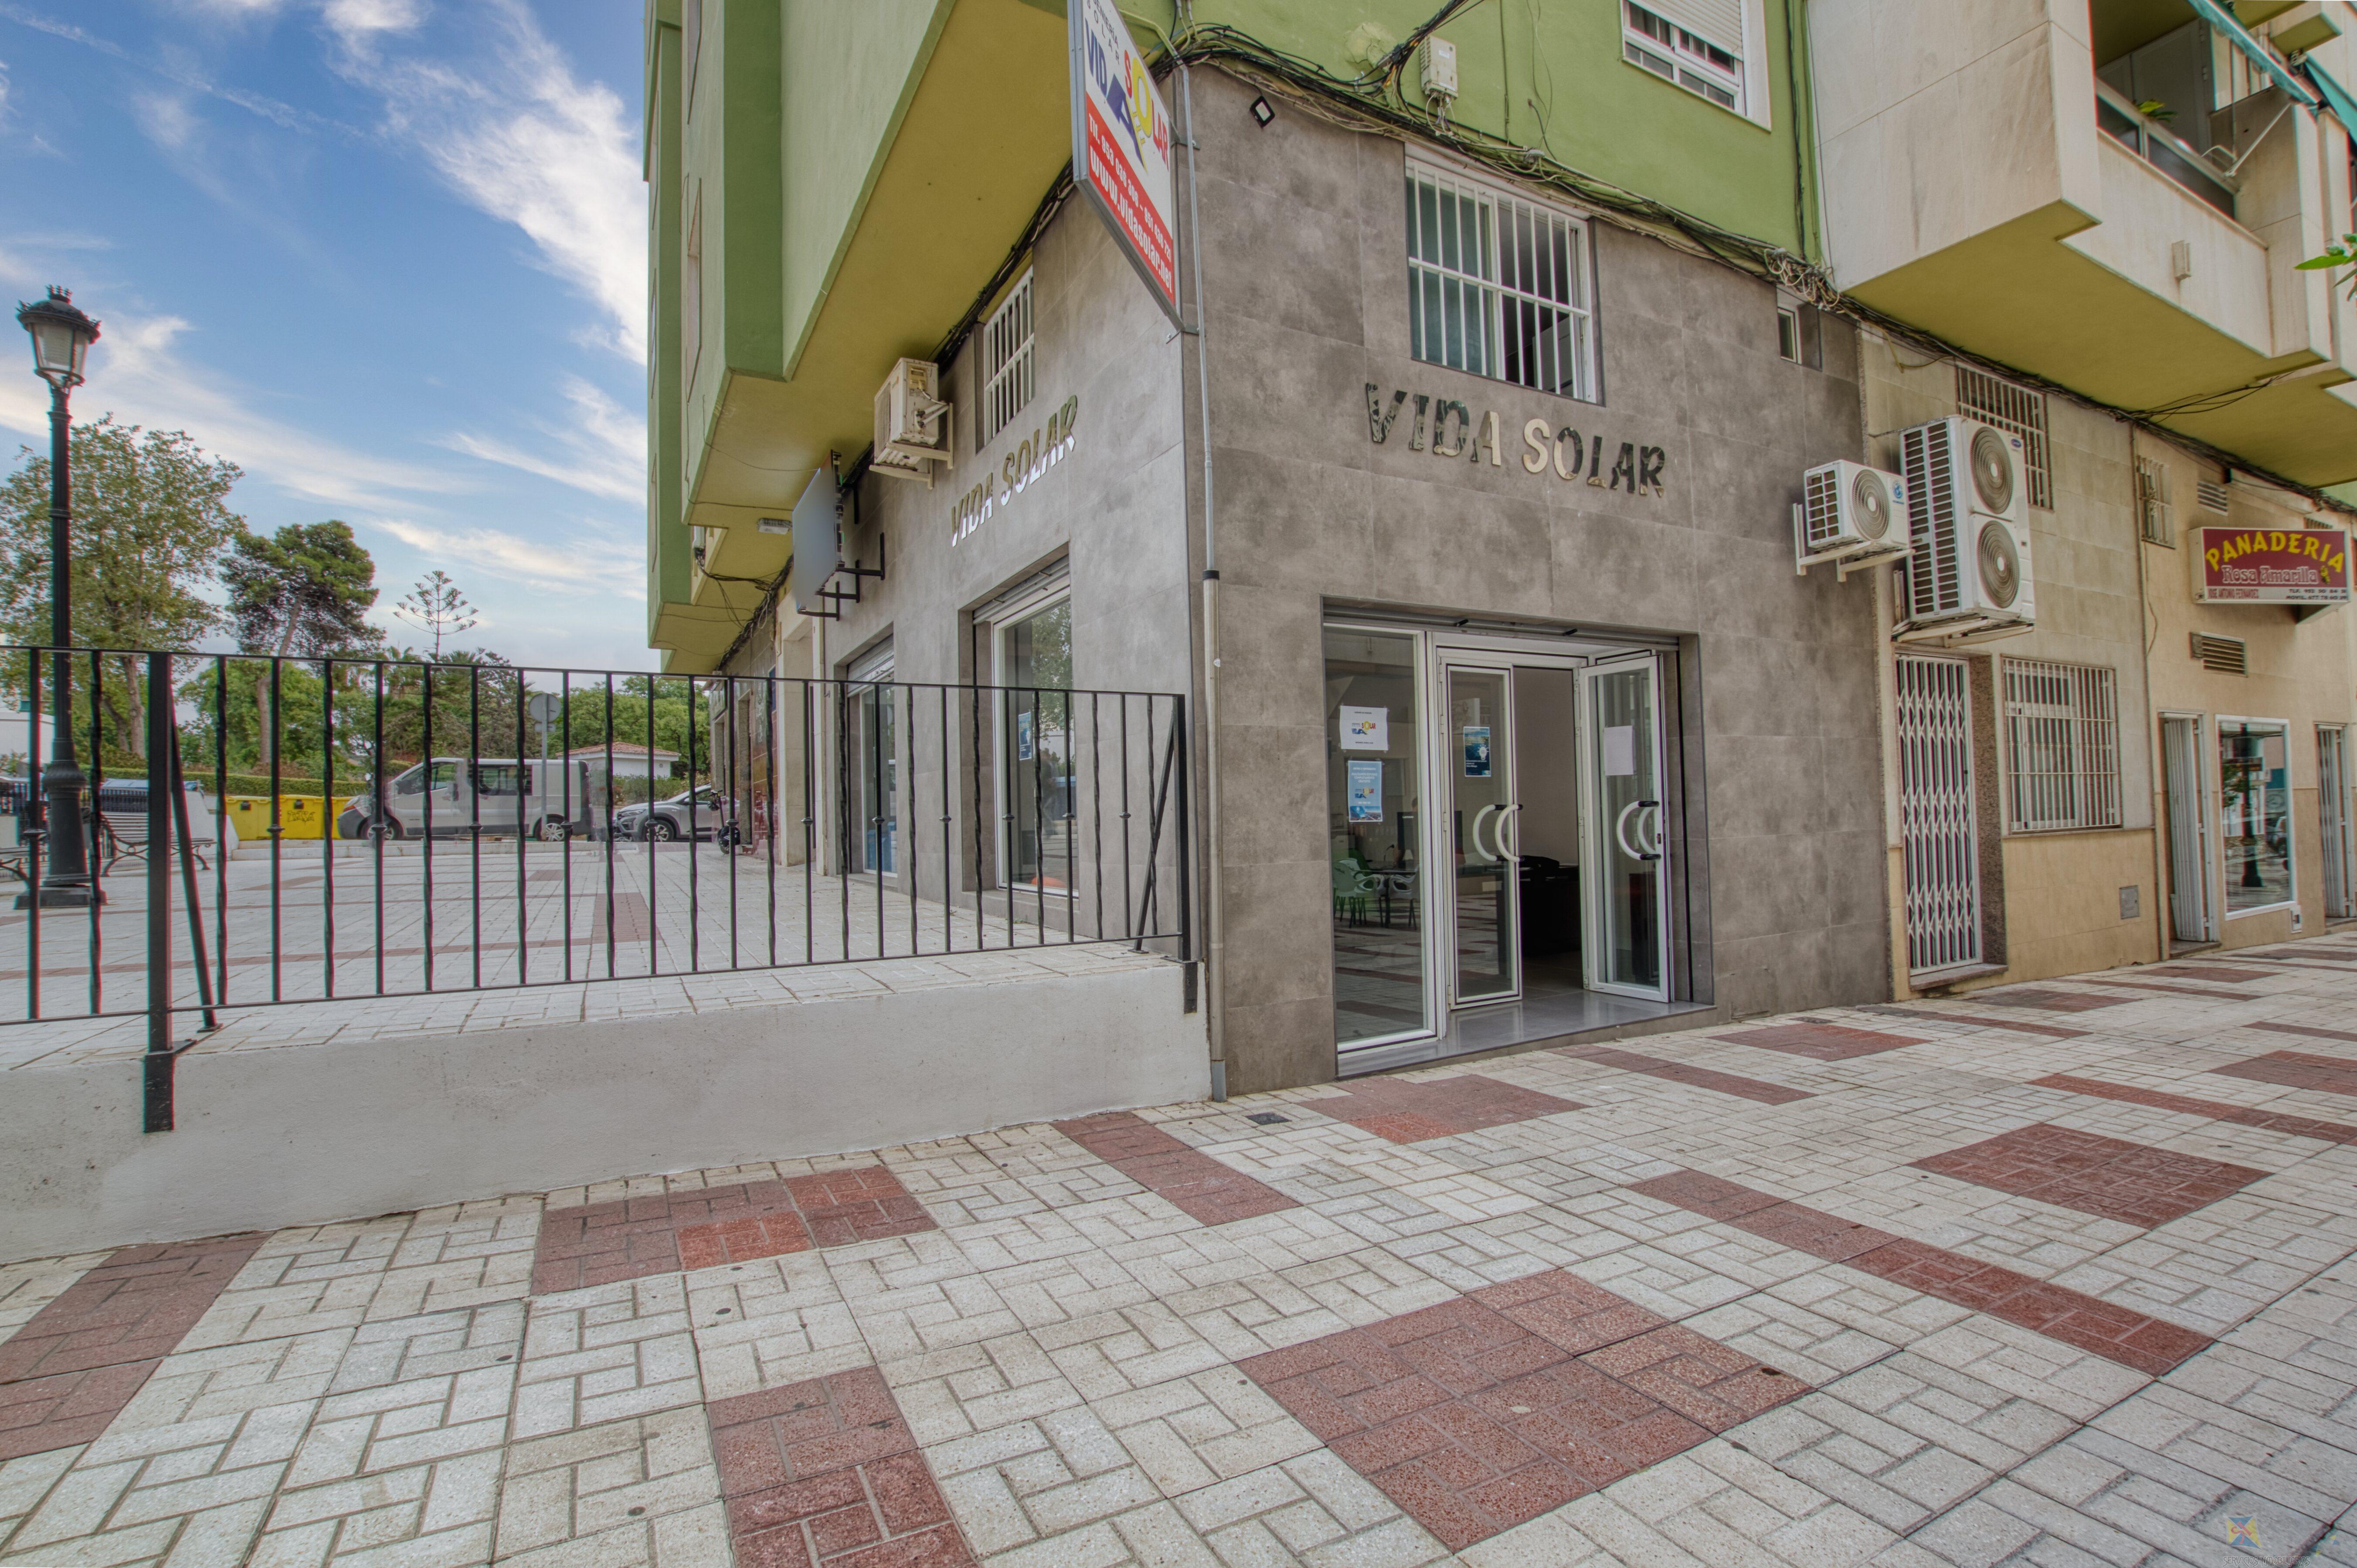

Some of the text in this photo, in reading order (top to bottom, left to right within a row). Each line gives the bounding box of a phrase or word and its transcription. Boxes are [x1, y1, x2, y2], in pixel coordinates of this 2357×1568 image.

[1085, 17, 1169, 172] VIDA SOLAR
[1101, 134, 1114, 166] 953
[1090, 144, 1172, 294] www.vidasolar.net
[951, 394, 1078, 548] VIDA SOLAR
[1365, 382, 1666, 497] VIDA SOLAR
[2205, 531, 2344, 573] PANADERIA
[2221, 565, 2319, 584] Rosa Amarilla
